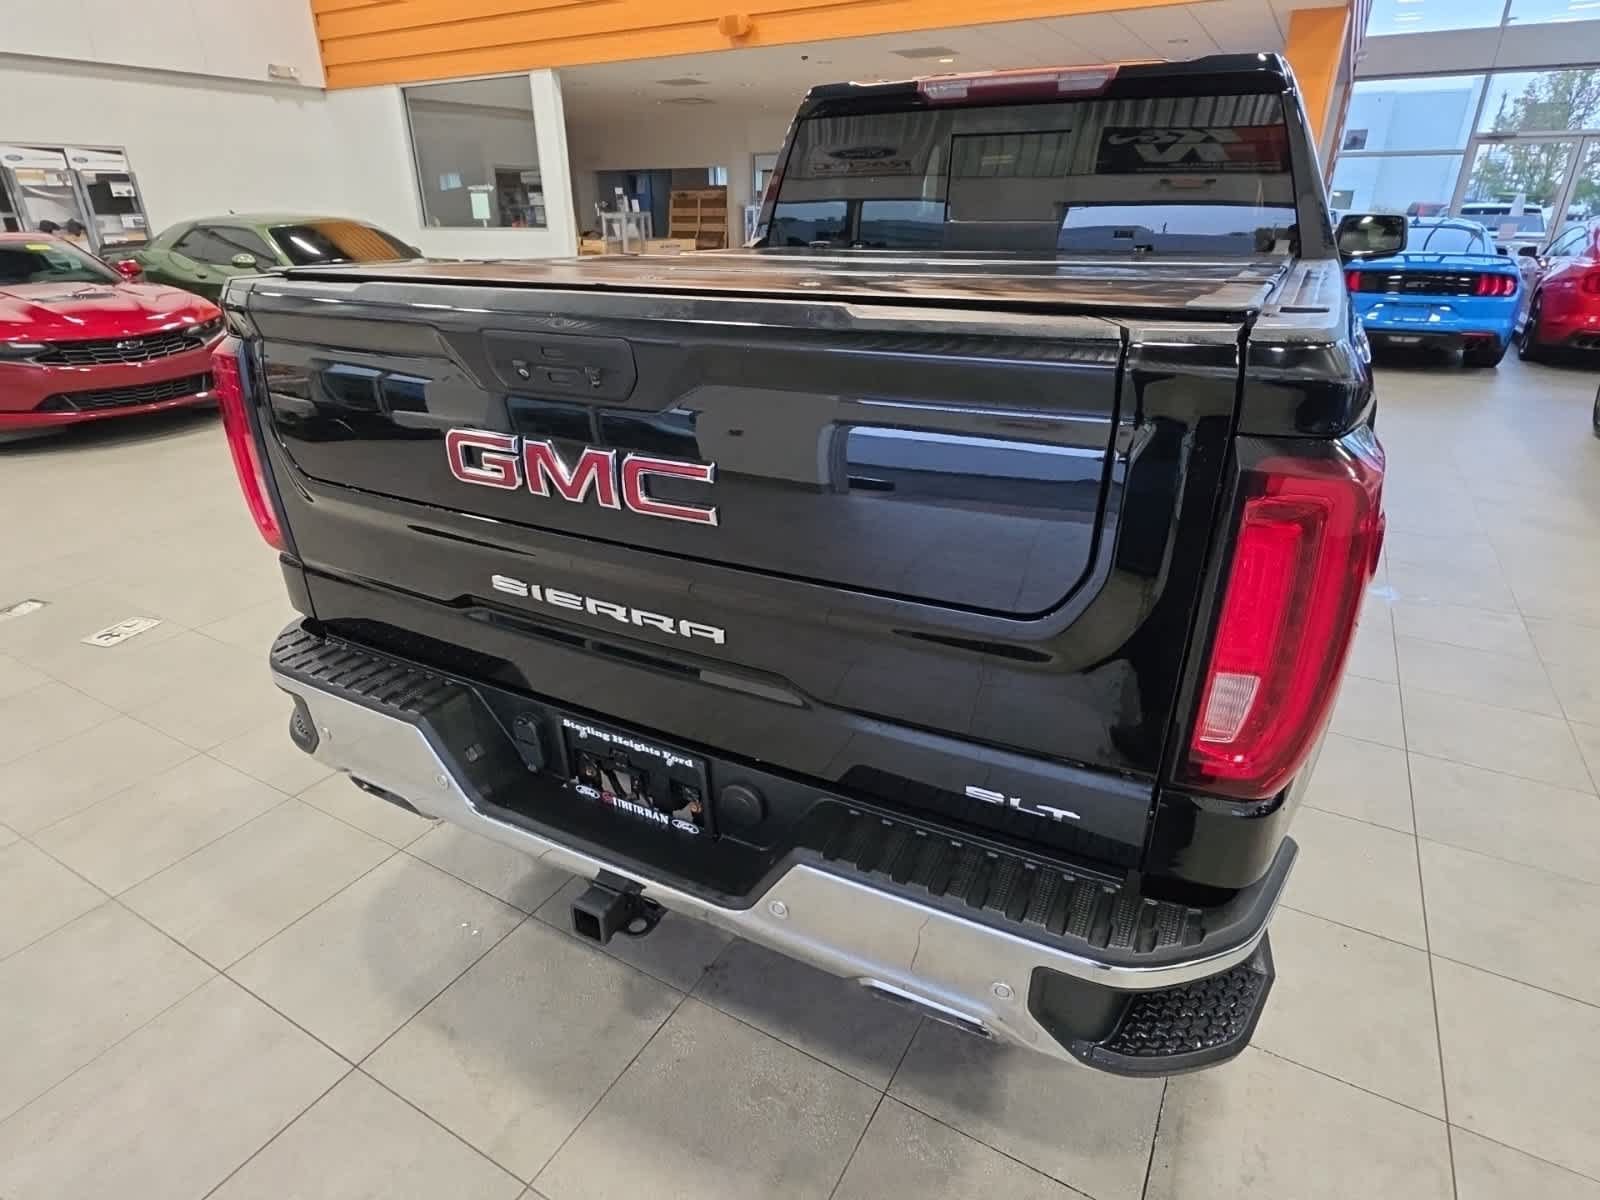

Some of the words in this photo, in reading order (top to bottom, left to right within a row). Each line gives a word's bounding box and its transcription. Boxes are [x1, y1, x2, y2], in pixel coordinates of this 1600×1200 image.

[446, 428, 718, 526] GMC
[491, 575, 725, 644] SIERRA
[563, 718, 610, 742] Sterling
[611, 734, 661, 757] Heights
[965, 785, 1081, 822] SLT
